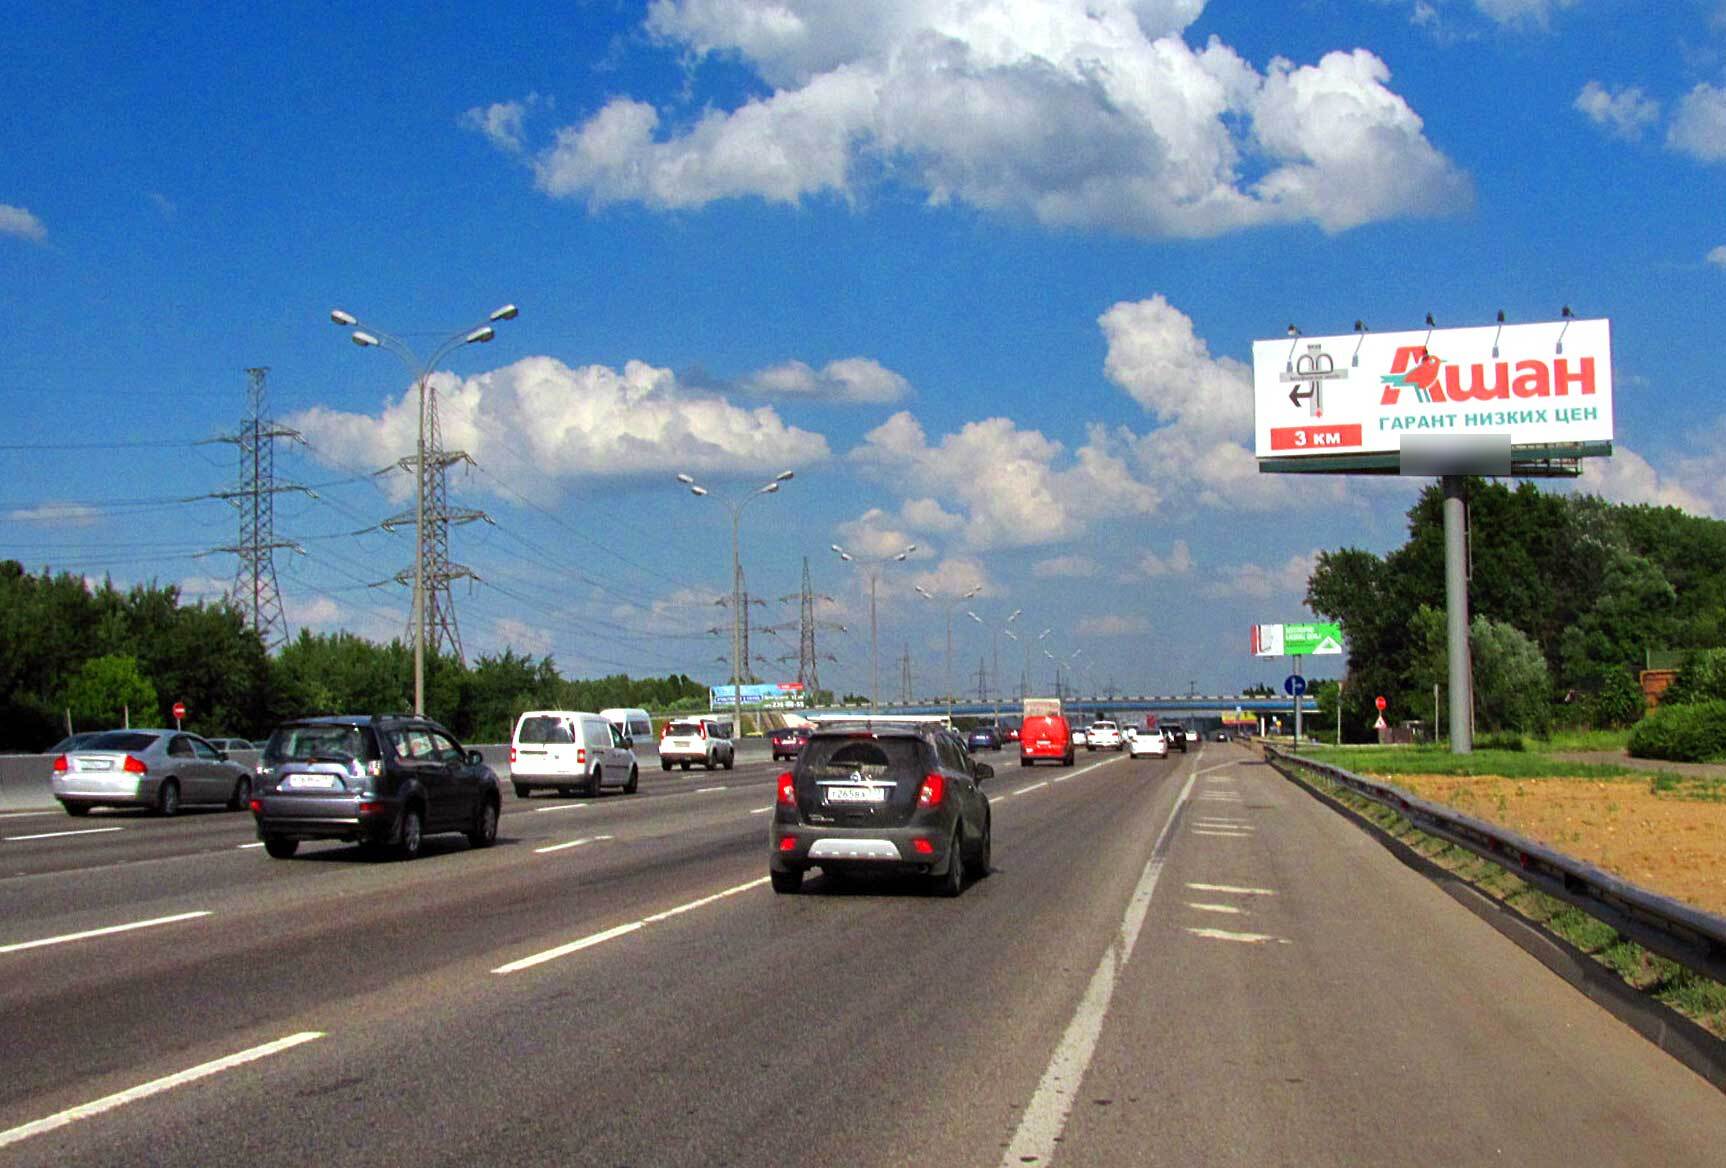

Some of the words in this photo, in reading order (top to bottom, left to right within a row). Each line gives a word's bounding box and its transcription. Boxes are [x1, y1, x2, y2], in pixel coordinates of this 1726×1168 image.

[1380, 346, 1596, 405] Ашан
[1379, 414, 1457, 431] ГАРАНТ
[1464, 409, 1548, 427] НИЗКИХ
[1555, 406, 1598, 424] ЦЕН
[1295, 430, 1306, 446] 3
